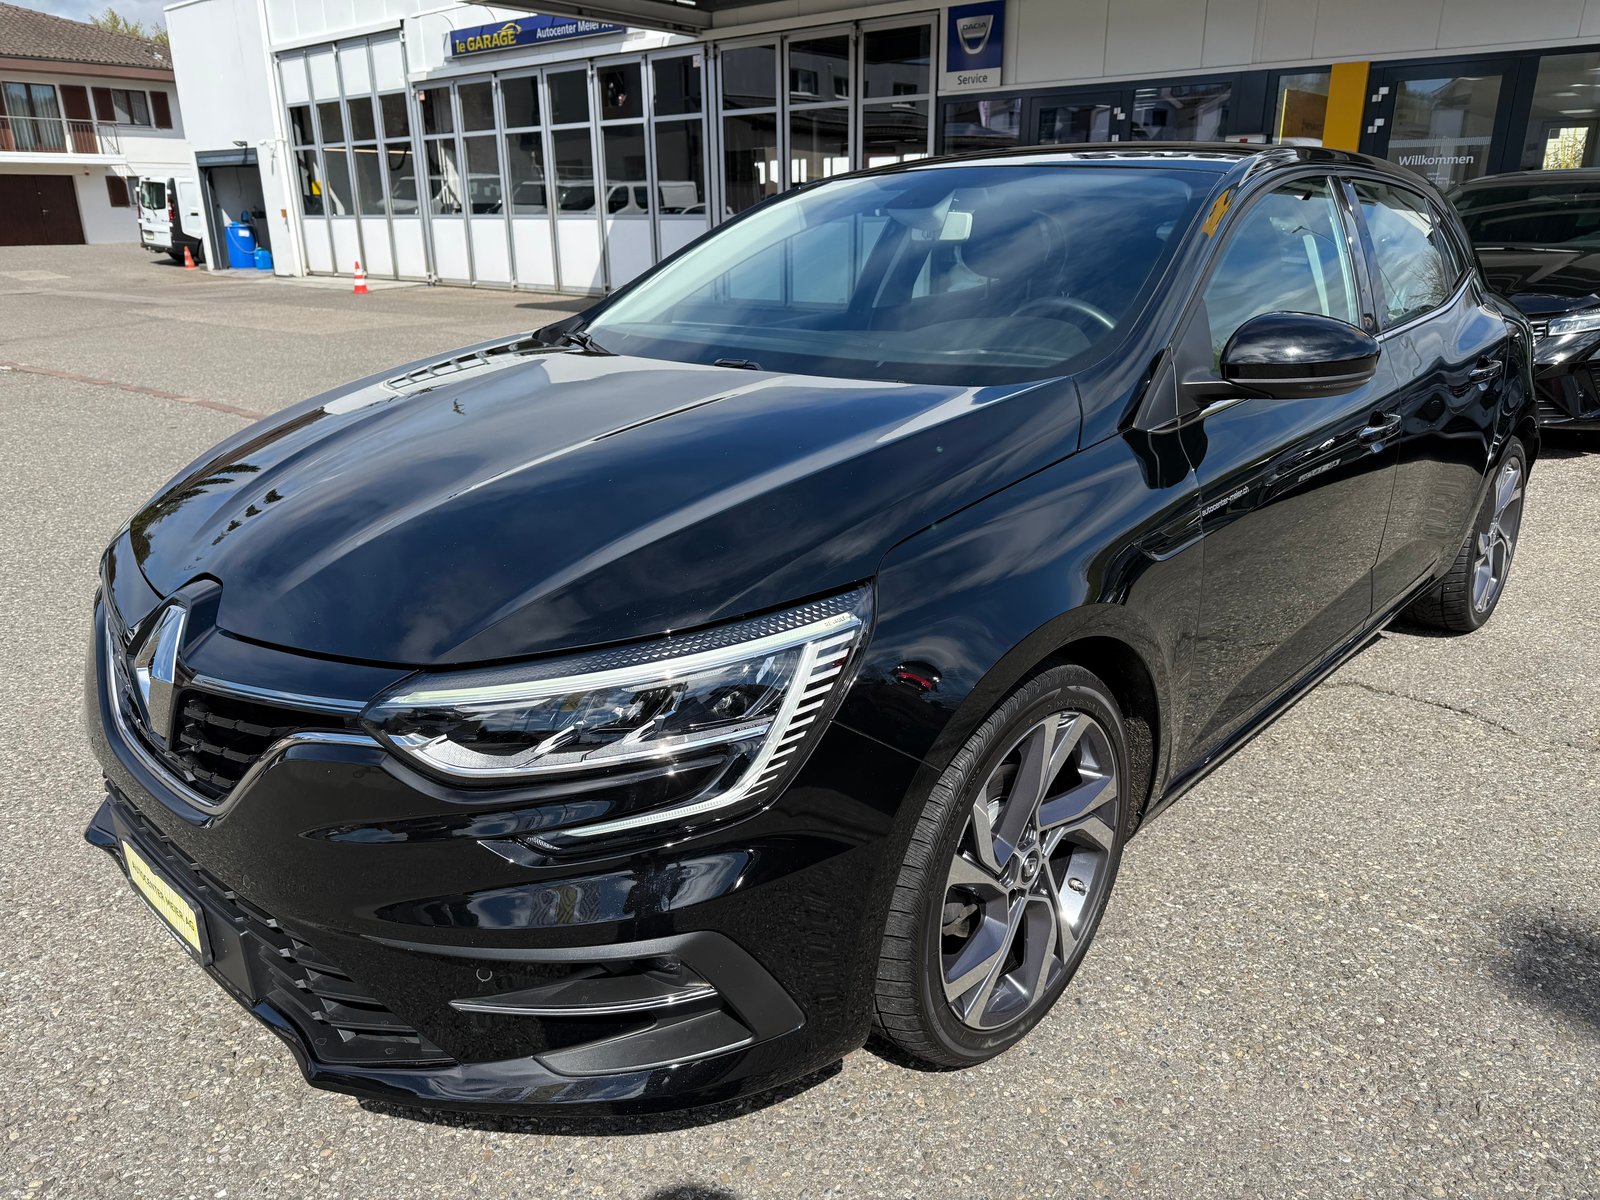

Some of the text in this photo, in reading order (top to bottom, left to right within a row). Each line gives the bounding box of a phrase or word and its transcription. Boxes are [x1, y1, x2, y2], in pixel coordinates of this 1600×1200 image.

[536, 23, 577, 39] Autocenter
[578, 20, 600, 32] Meier
[962, 22, 987, 31] DACIA
[456, 30, 516, 53] le GARAGE
[957, 73, 988, 86] Service
[1398, 154, 1474, 166] Willkommen
[1201, 485, 1250, 517] autocenter-meier.ch
